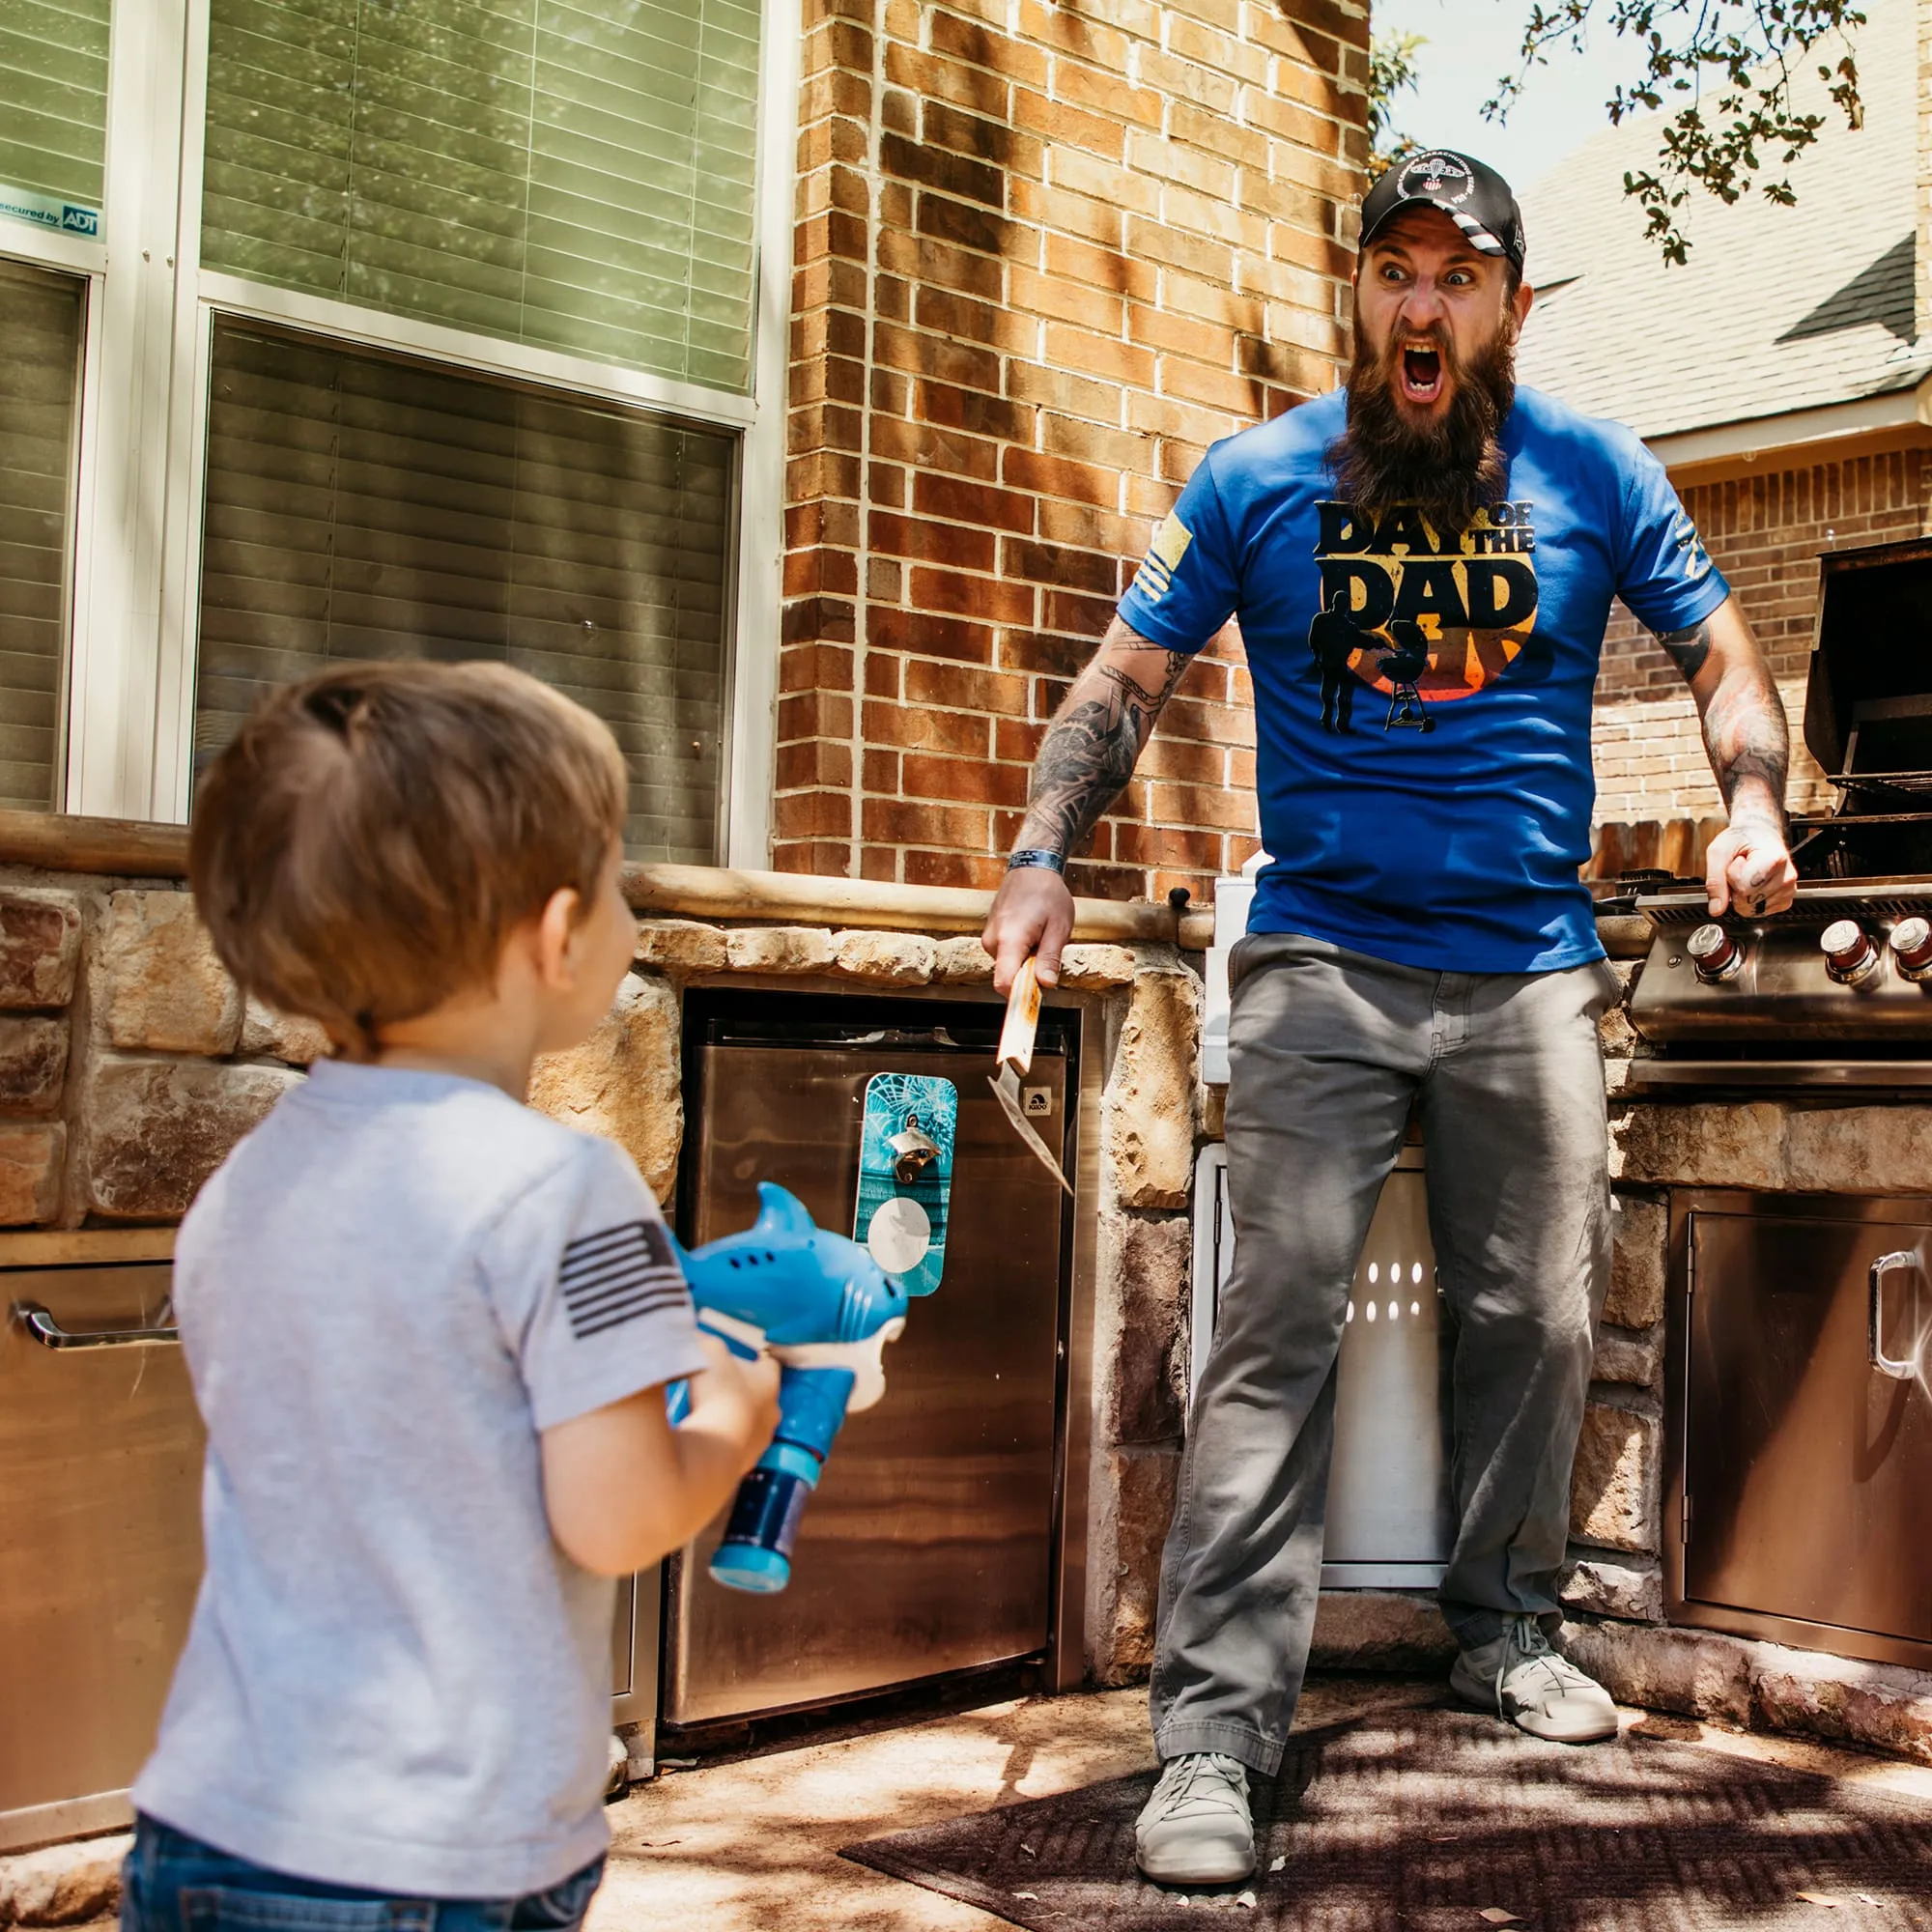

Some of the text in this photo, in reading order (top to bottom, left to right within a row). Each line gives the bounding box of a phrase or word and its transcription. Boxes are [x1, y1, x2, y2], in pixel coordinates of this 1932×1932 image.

[0, 203, 98, 232] secured by ADT
[1487, 500, 1534, 527] OF
[1467, 527, 1536, 554] THE
[1314, 557, 1539, 630] DAD
